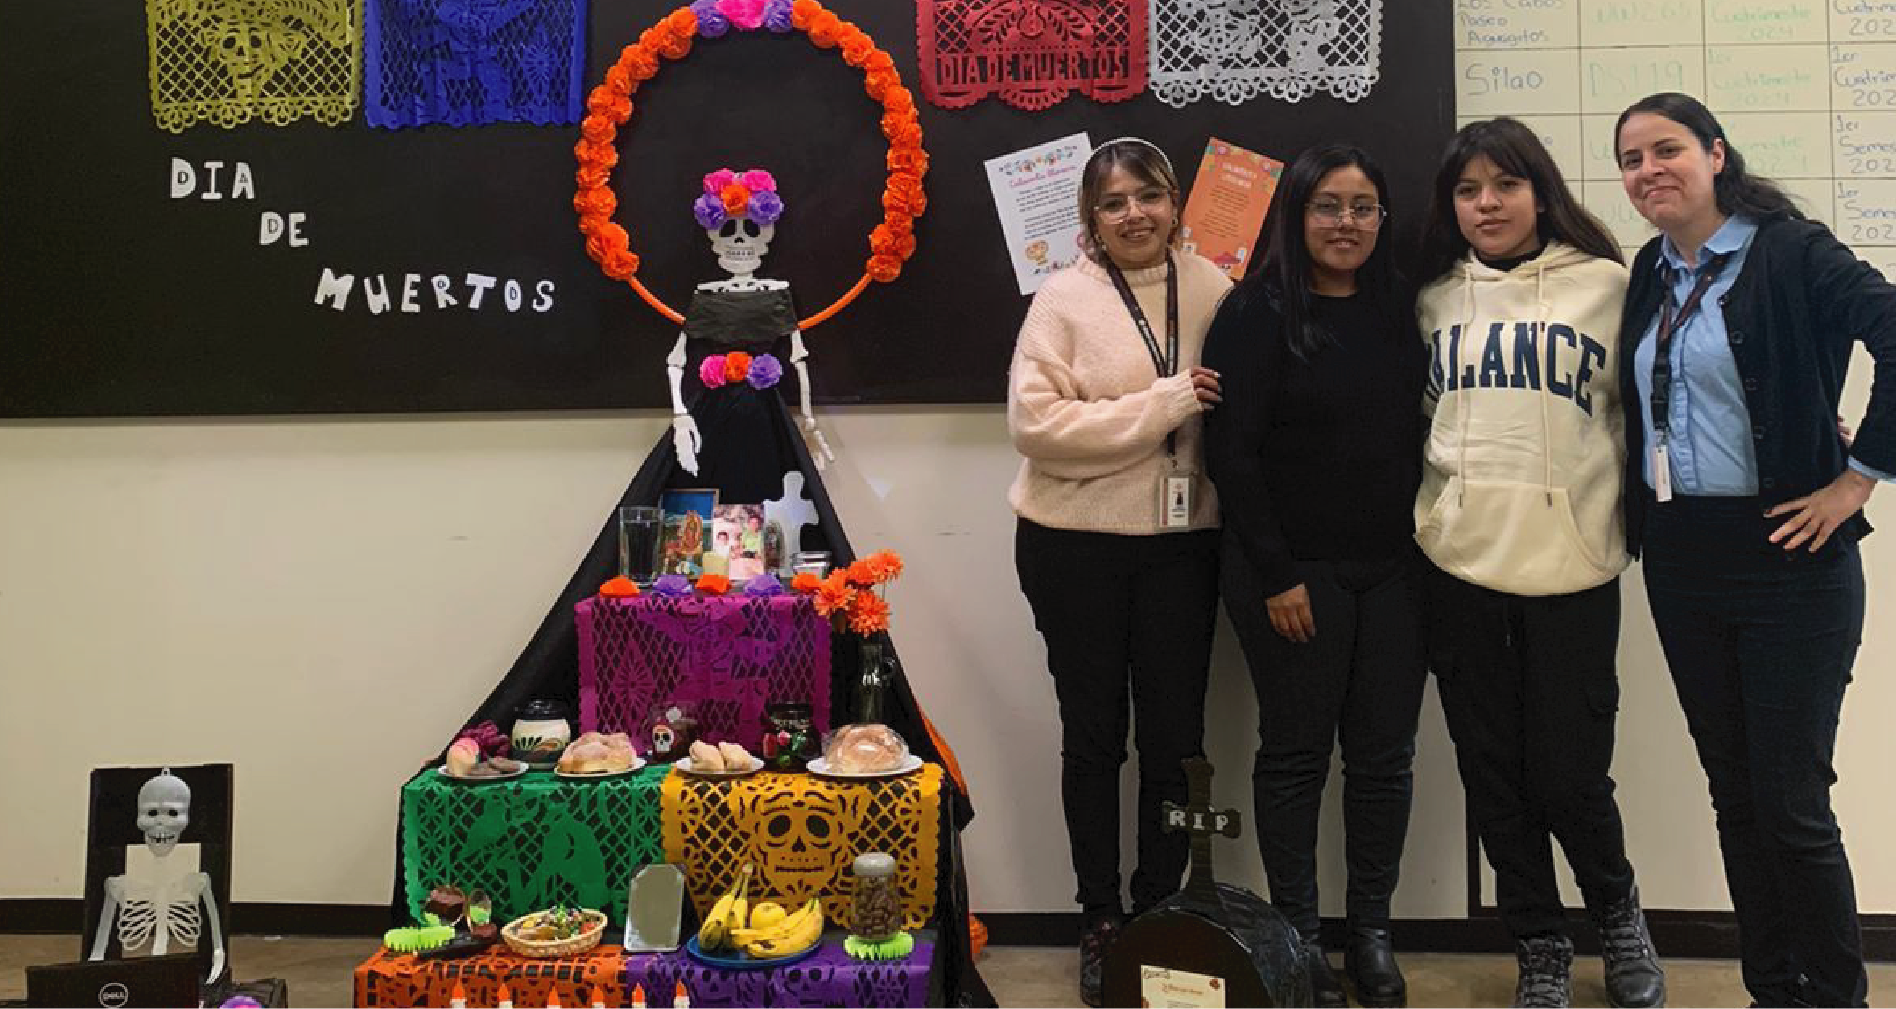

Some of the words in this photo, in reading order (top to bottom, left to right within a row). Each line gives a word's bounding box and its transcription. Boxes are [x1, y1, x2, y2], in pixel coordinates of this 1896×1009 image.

[1017, 50, 1131, 81] MUERTOS
[1832, 45, 1860, 64] 1er
[1465, 63, 1543, 96] Silao
[1837, 114, 1859, 133] 1er
[170, 157, 256, 200] DIA
[1837, 180, 1860, 199] 1er
[259, 211, 309, 248] DE
[314, 267, 556, 316] MUERTOS
[1168, 810, 1229, 831] RIP
